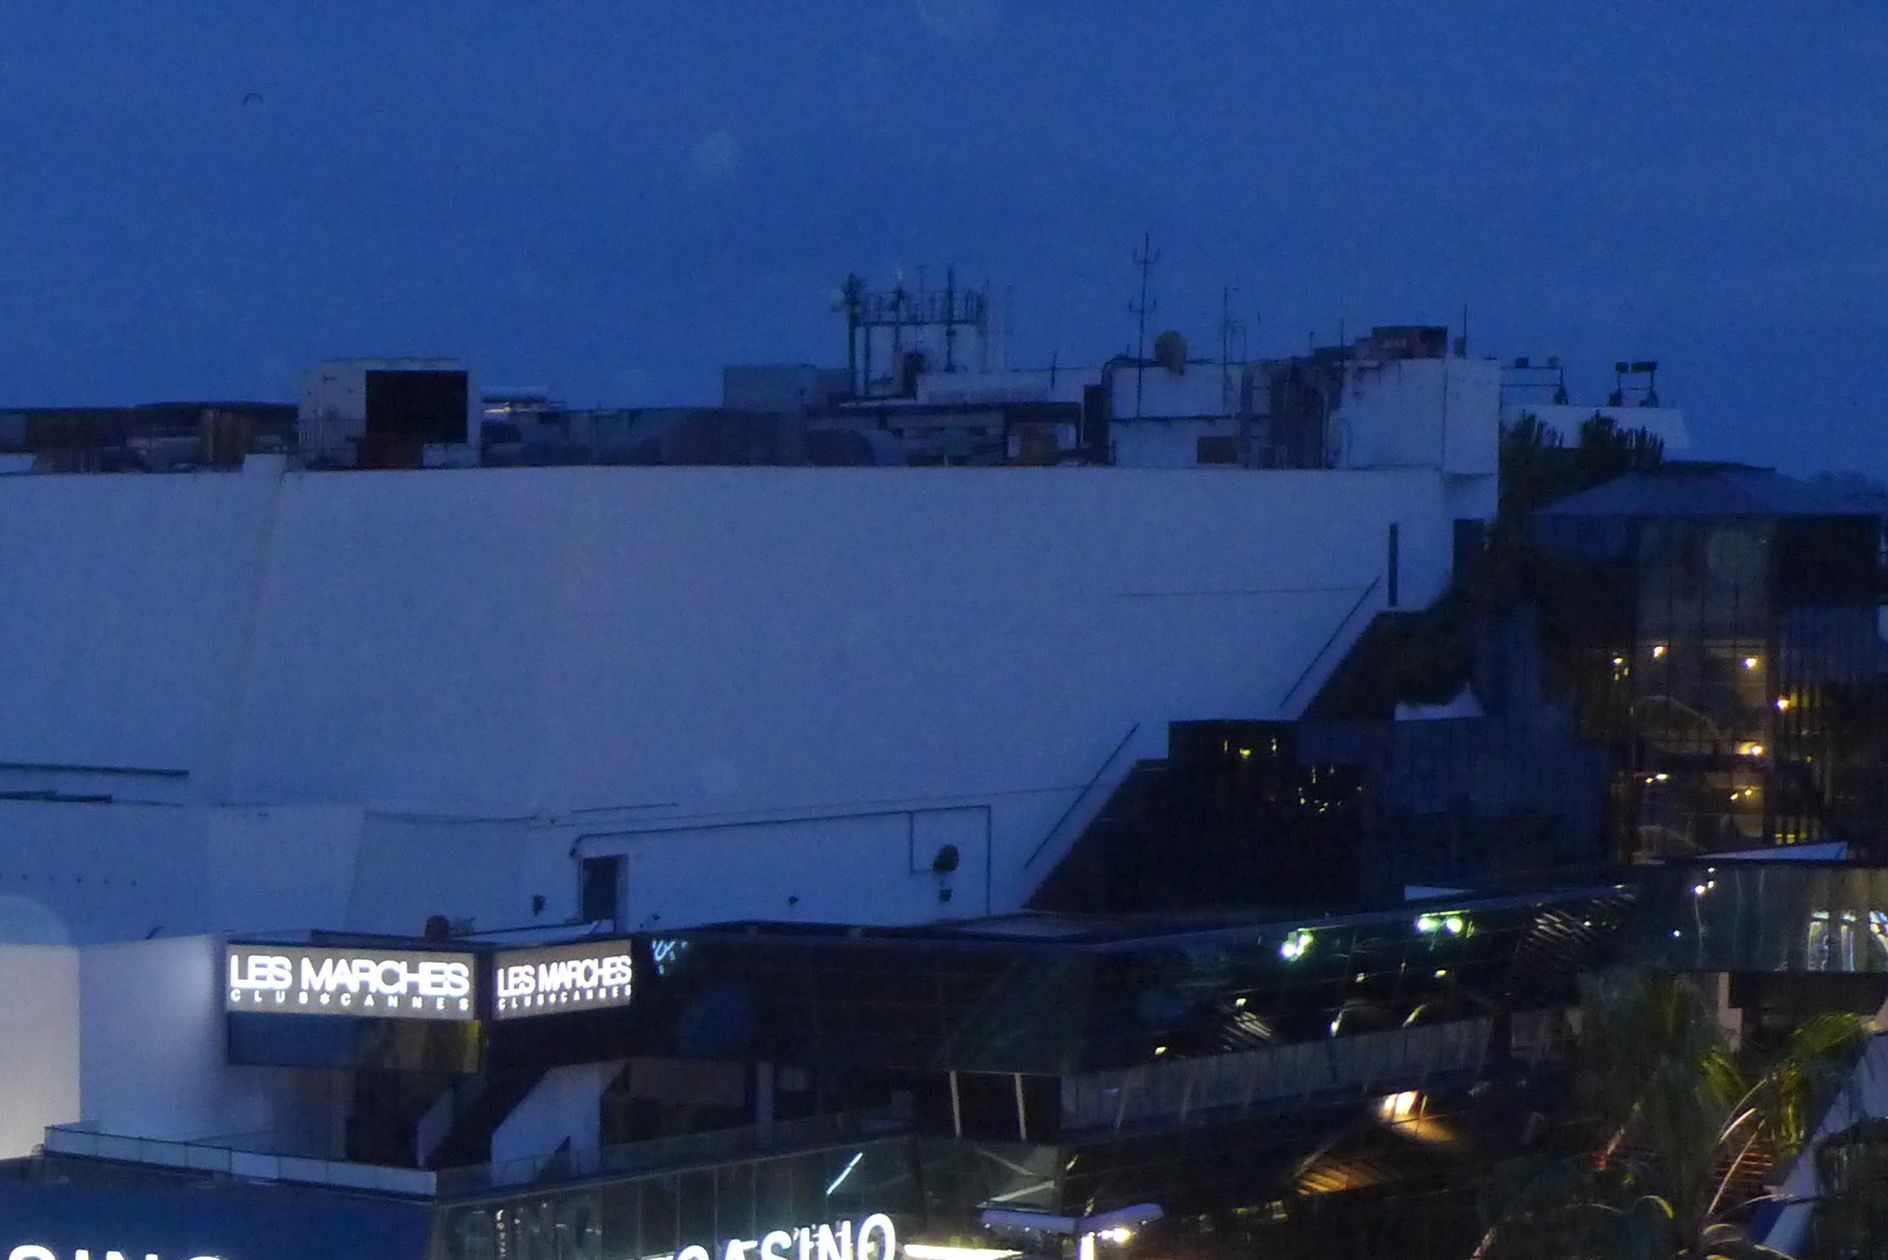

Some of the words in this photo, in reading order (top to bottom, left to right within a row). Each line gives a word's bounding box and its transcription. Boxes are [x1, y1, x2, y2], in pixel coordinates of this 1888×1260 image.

[230, 954, 293, 989] LES
[301, 956, 470, 996] MARCHES
[497, 964, 536, 998] LES
[538, 955, 632, 993] MARCHES
